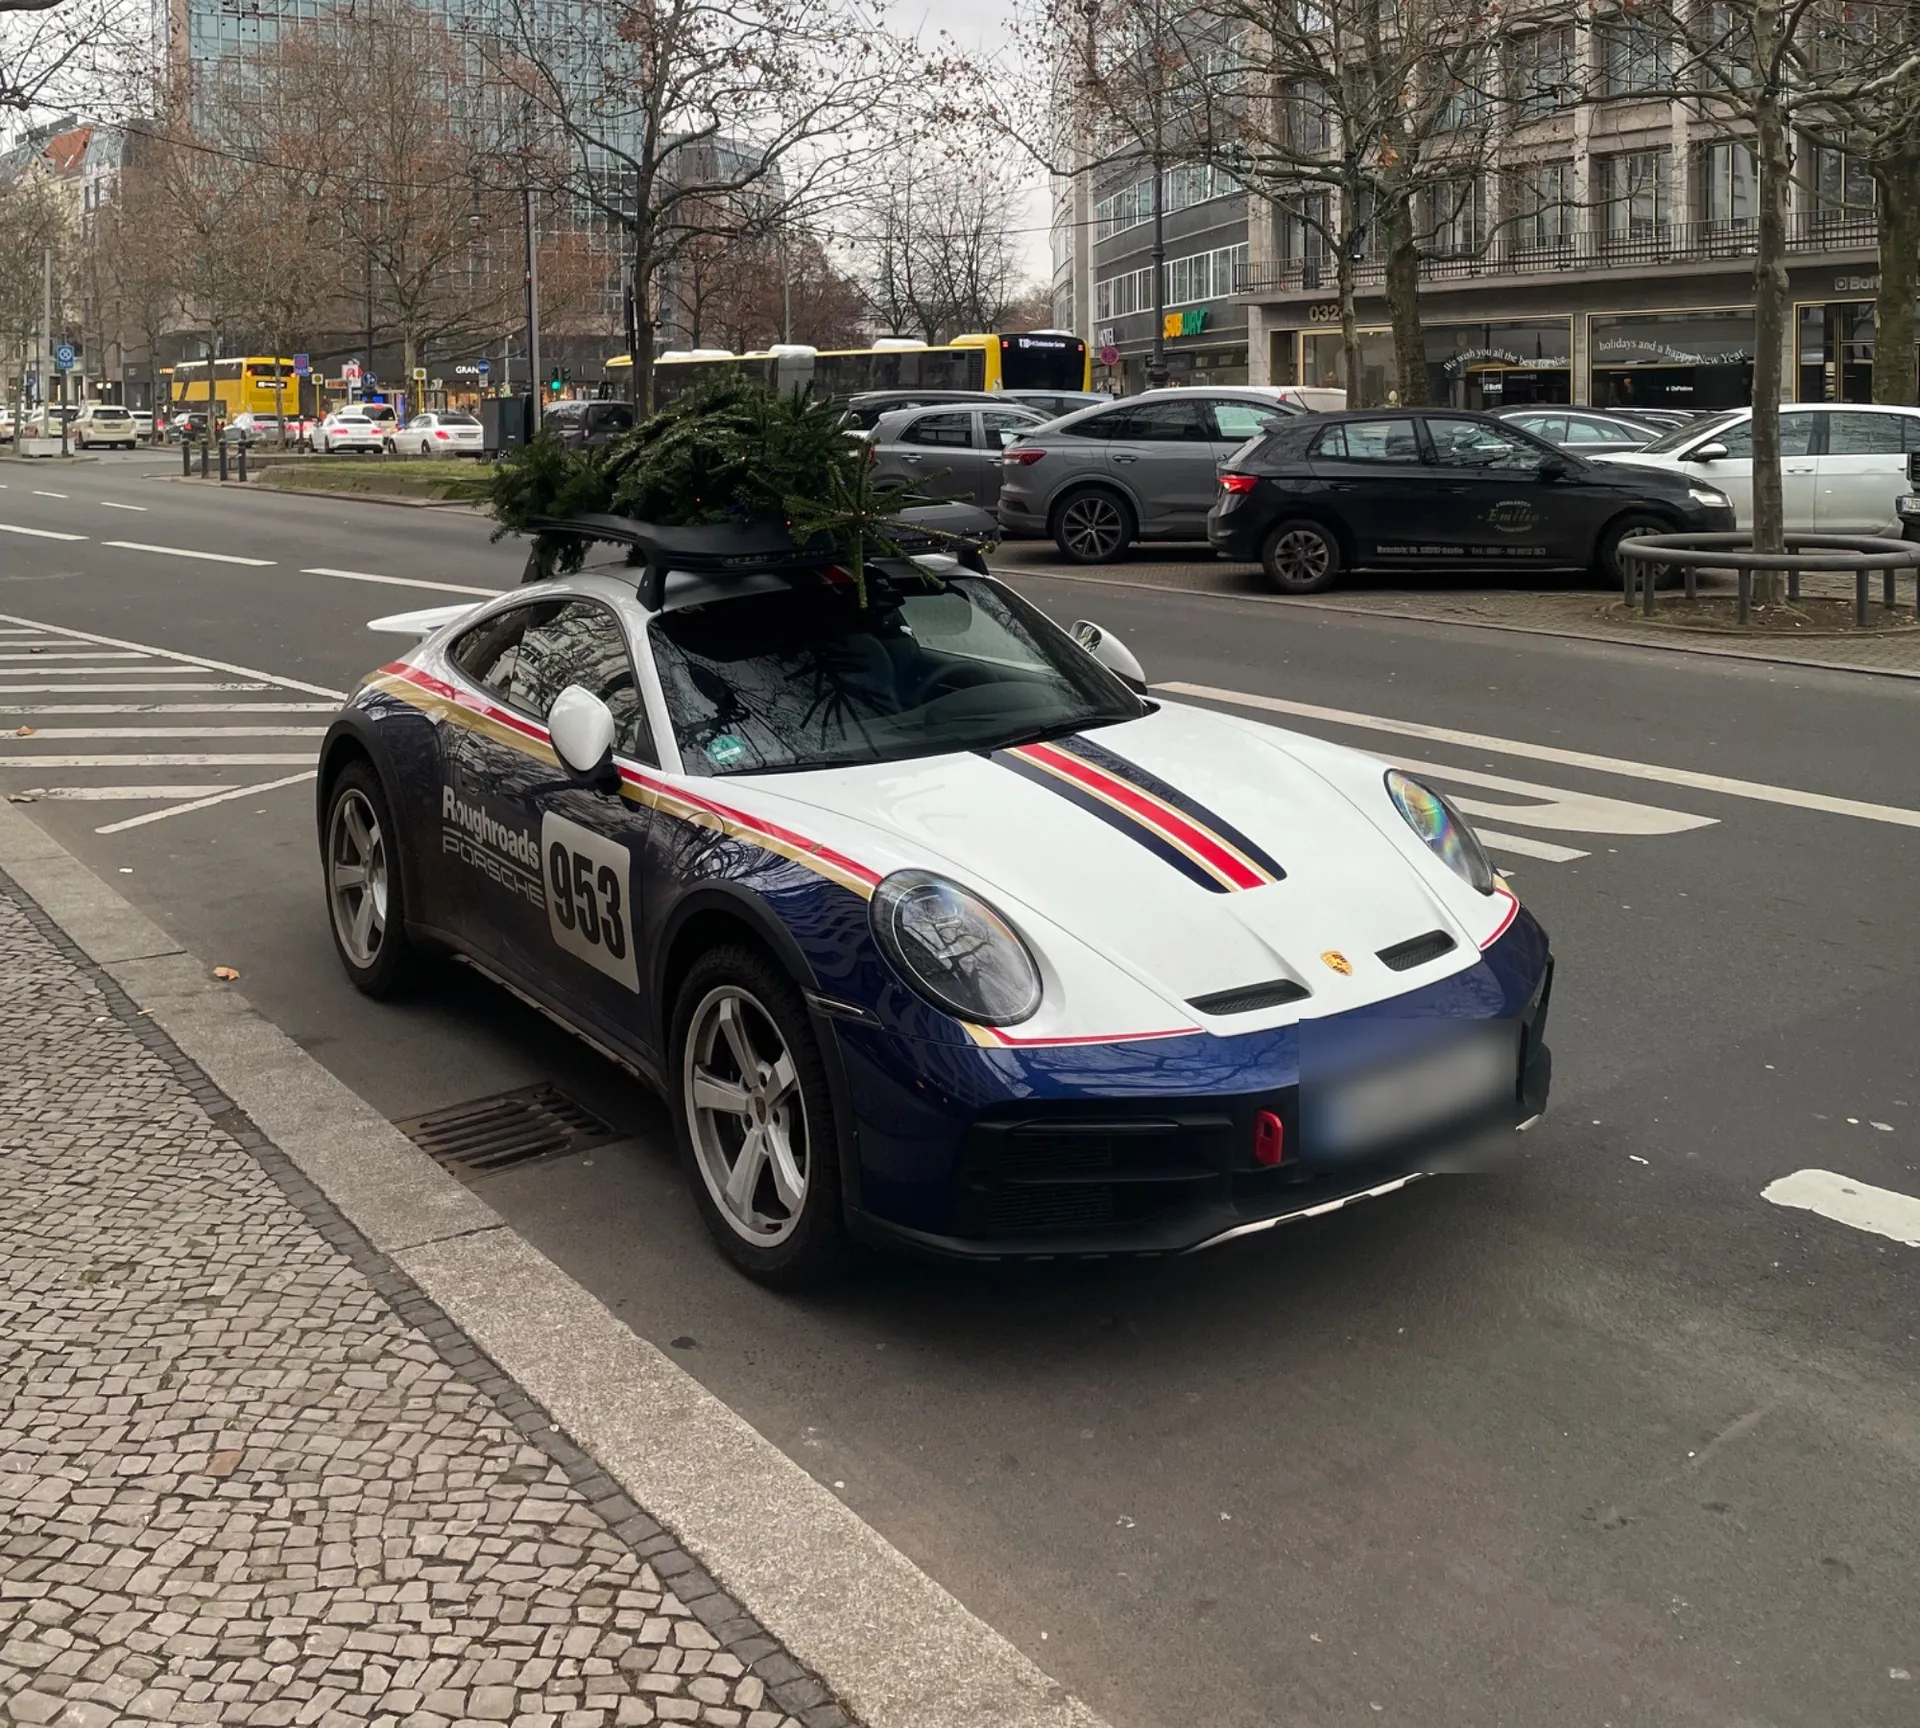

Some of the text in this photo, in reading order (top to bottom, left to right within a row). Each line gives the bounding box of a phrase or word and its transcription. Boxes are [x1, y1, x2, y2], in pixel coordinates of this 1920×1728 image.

[1163, 306, 1208, 340] SUBWAY
[1308, 304, 1342, 322] 032
[1443, 359, 1457, 371] We
[1456, 349, 1475, 362] wish
[1476, 348, 1492, 359] you
[1493, 348, 1504, 359] all
[1504, 352, 1518, 363] the
[1598, 338, 1637, 351] holidays
[1638, 340, 1657, 351] and
[1657, 344, 1664, 353] a
[1664, 345, 1698, 364] happy
[1697, 353, 1720, 365] New
[442, 785, 540, 870] Roughroads
[442, 834, 546, 910] PORSCHE
[550, 841, 626, 960] 953
